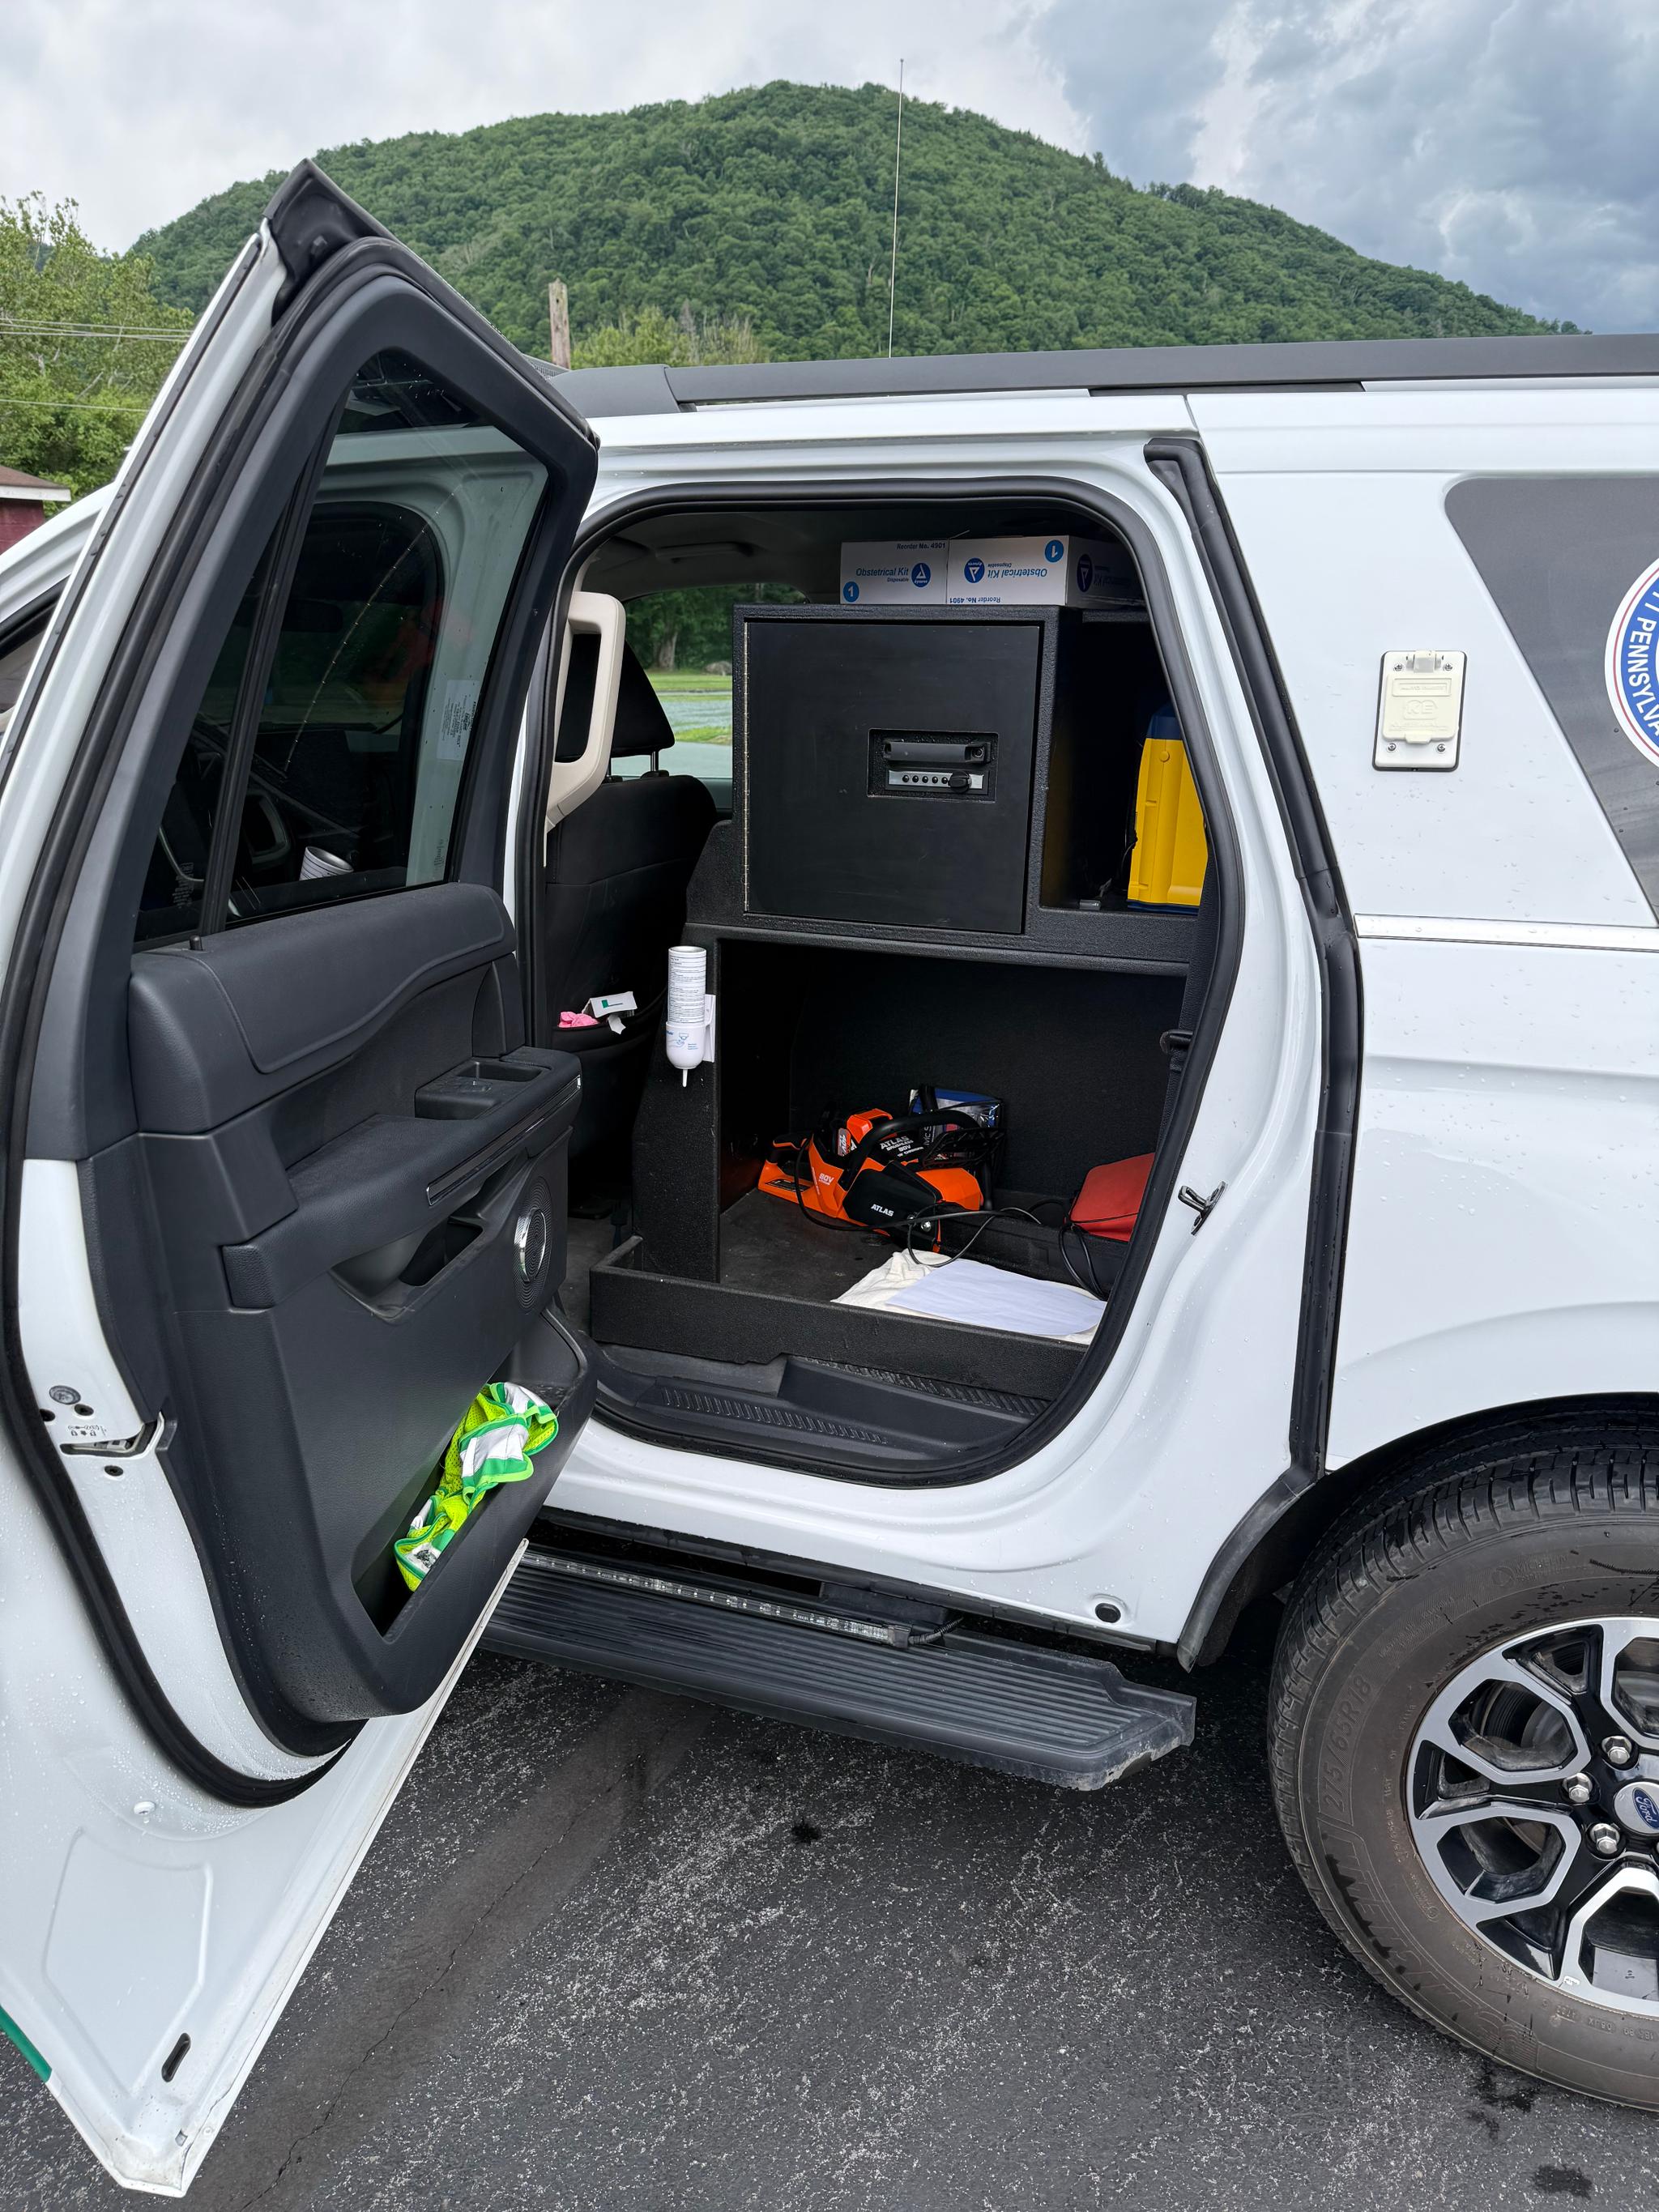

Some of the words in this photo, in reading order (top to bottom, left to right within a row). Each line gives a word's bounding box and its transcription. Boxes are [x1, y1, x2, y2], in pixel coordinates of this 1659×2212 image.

[855, 567, 897, 577] Obstetrical
[898, 567, 909, 576] Kit
[987, 569, 1000, 579] Kit
[1000, 568, 1048, 578] Obstetrical
[880, 1136, 910, 1150] ATLAS
[870, 1203, 894, 1217] ATLAS
[1636, 1796, 1658, 1824] Ford
